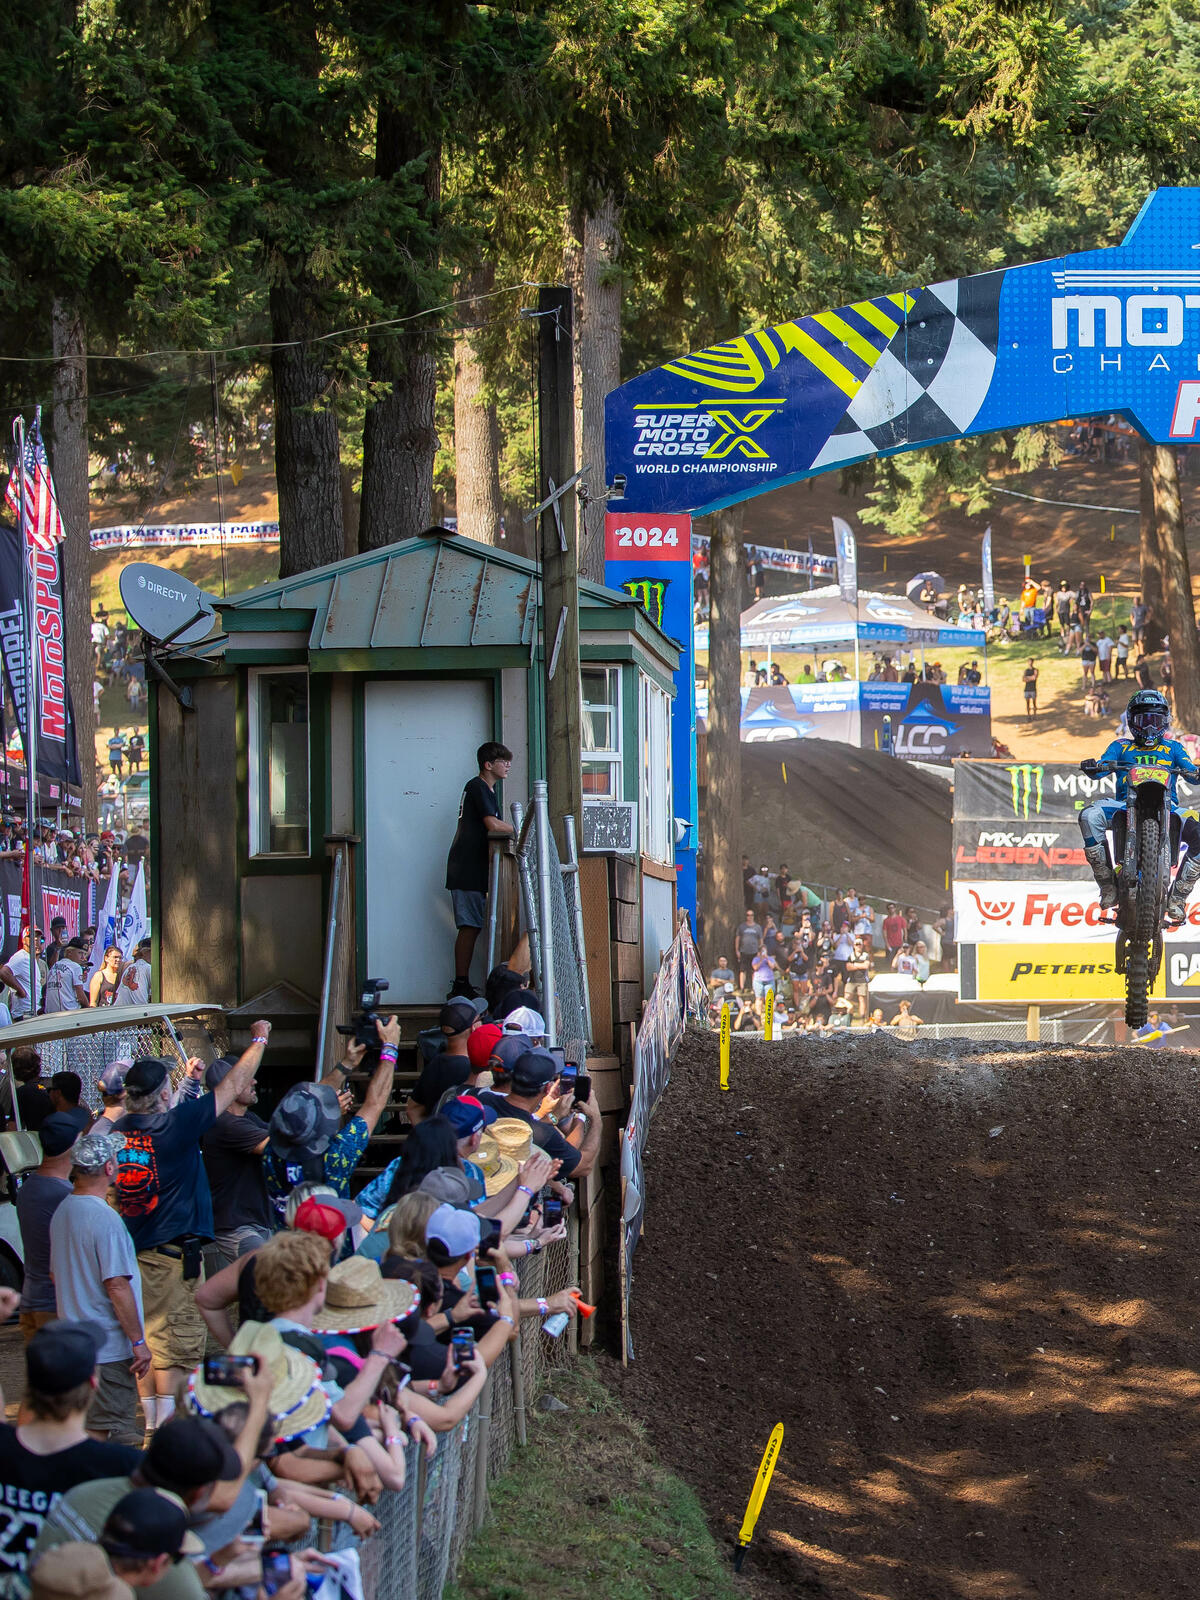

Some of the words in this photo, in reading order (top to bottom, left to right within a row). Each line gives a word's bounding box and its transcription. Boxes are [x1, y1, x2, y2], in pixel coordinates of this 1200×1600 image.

[633, 414, 715, 428] SUPER
[638, 428, 710, 442] MOTO
[633, 442, 711, 456] CROSS
[635, 464, 680, 474] WORLD
[682, 462, 778, 473] CHAMPIONSHIP
[618, 527, 679, 547] 2024
[147, 580, 188, 602] DIRECTV
[895, 724, 949, 755] LCC
[1010, 962, 1116, 982] PETERS
[761, 1438, 778, 1479] ACERBIS
